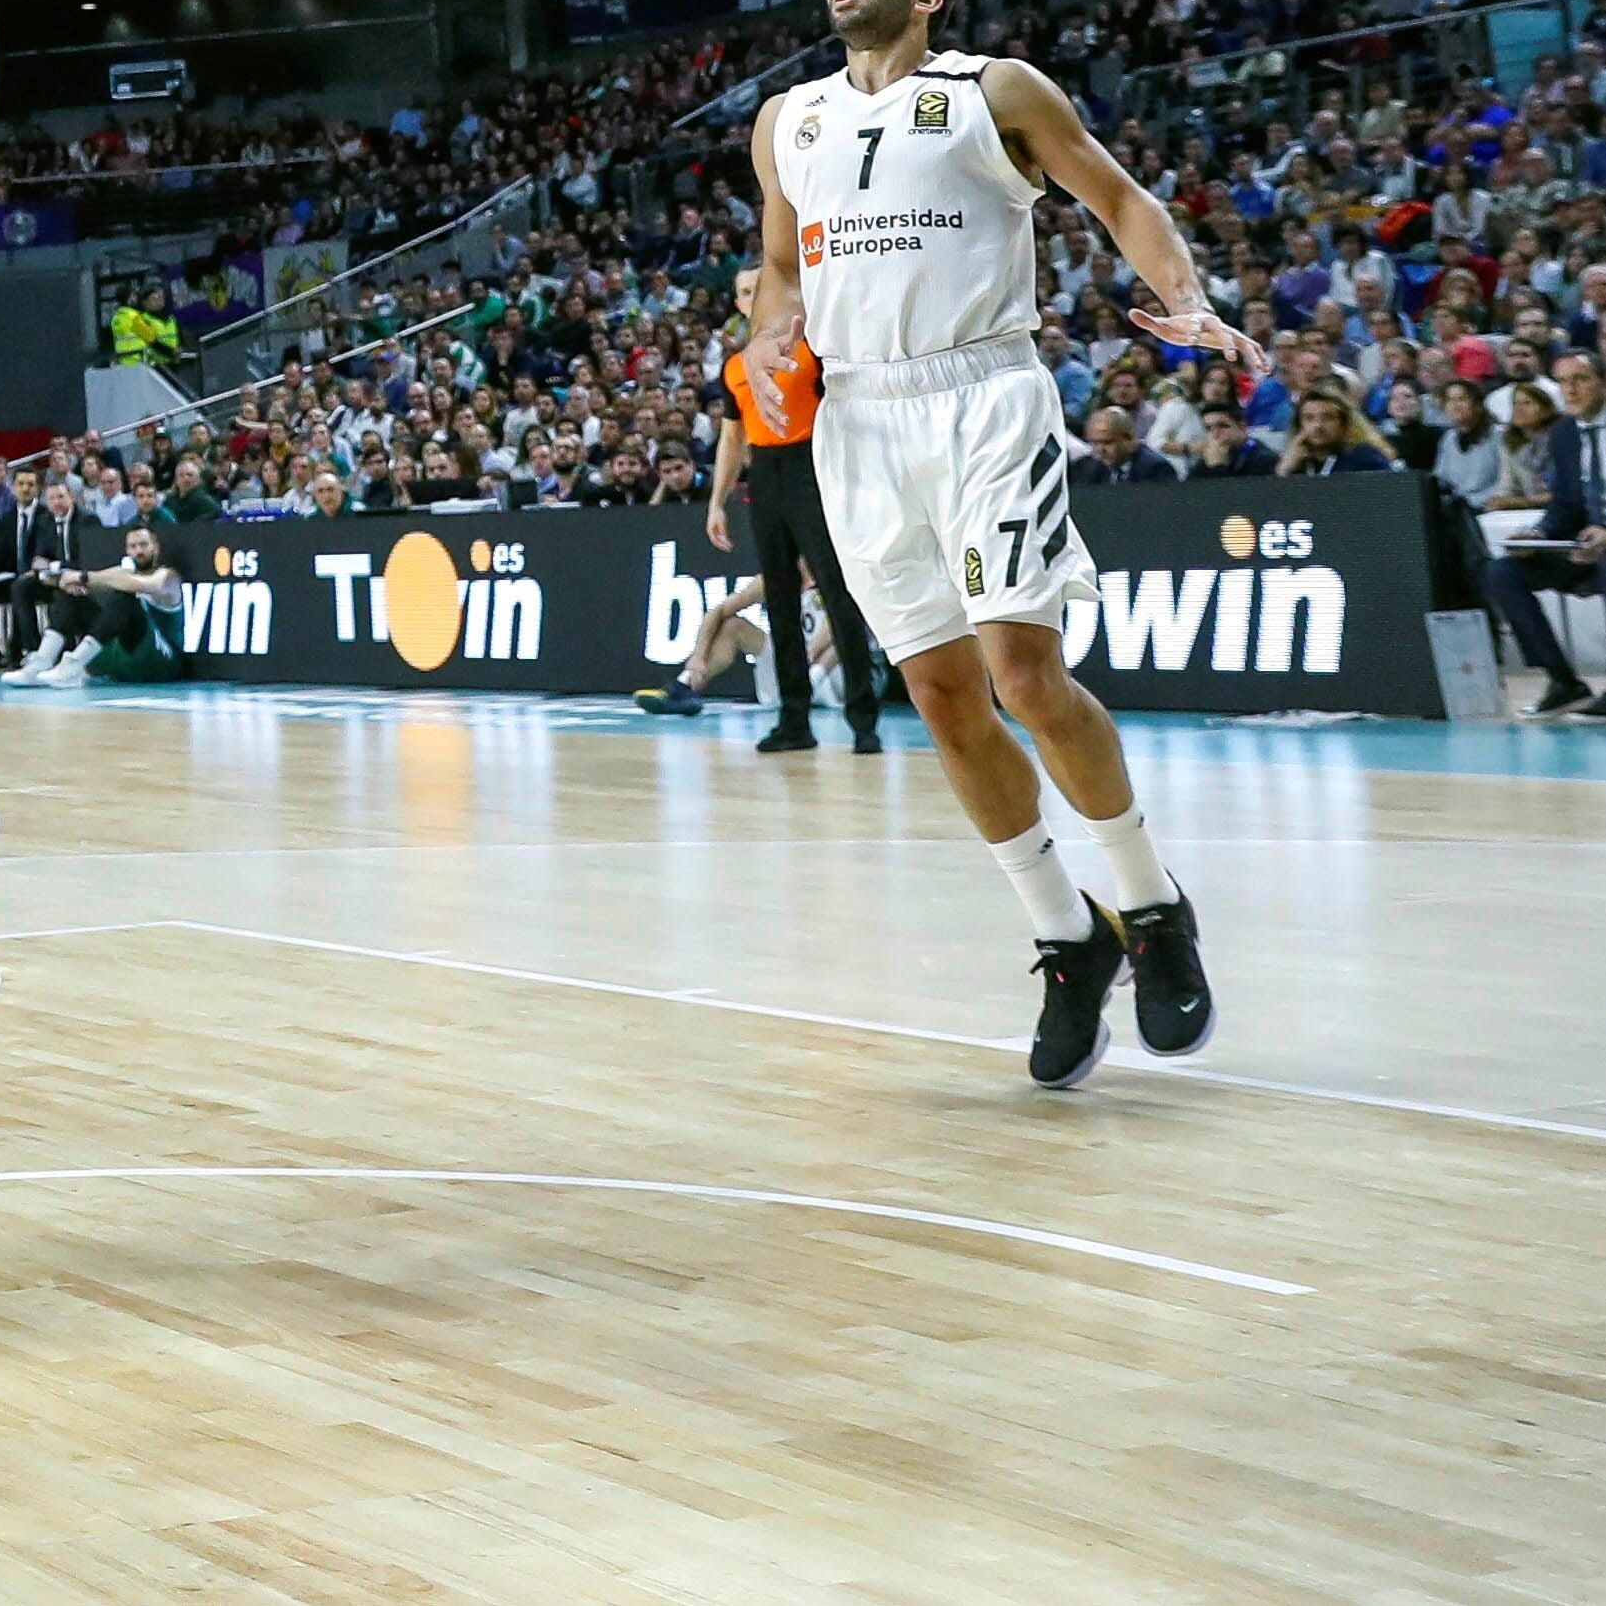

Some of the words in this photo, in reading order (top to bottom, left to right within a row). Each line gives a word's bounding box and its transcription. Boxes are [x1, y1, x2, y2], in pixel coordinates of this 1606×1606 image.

[858, 127, 885, 190] 7
[829, 209, 964, 234] Universidad
[830, 236, 922, 257] Europea
[997, 519, 1029, 588] 7
[1259, 519, 1315, 560] es
[232, 548, 260, 578] es
[493, 542, 526, 574] es
